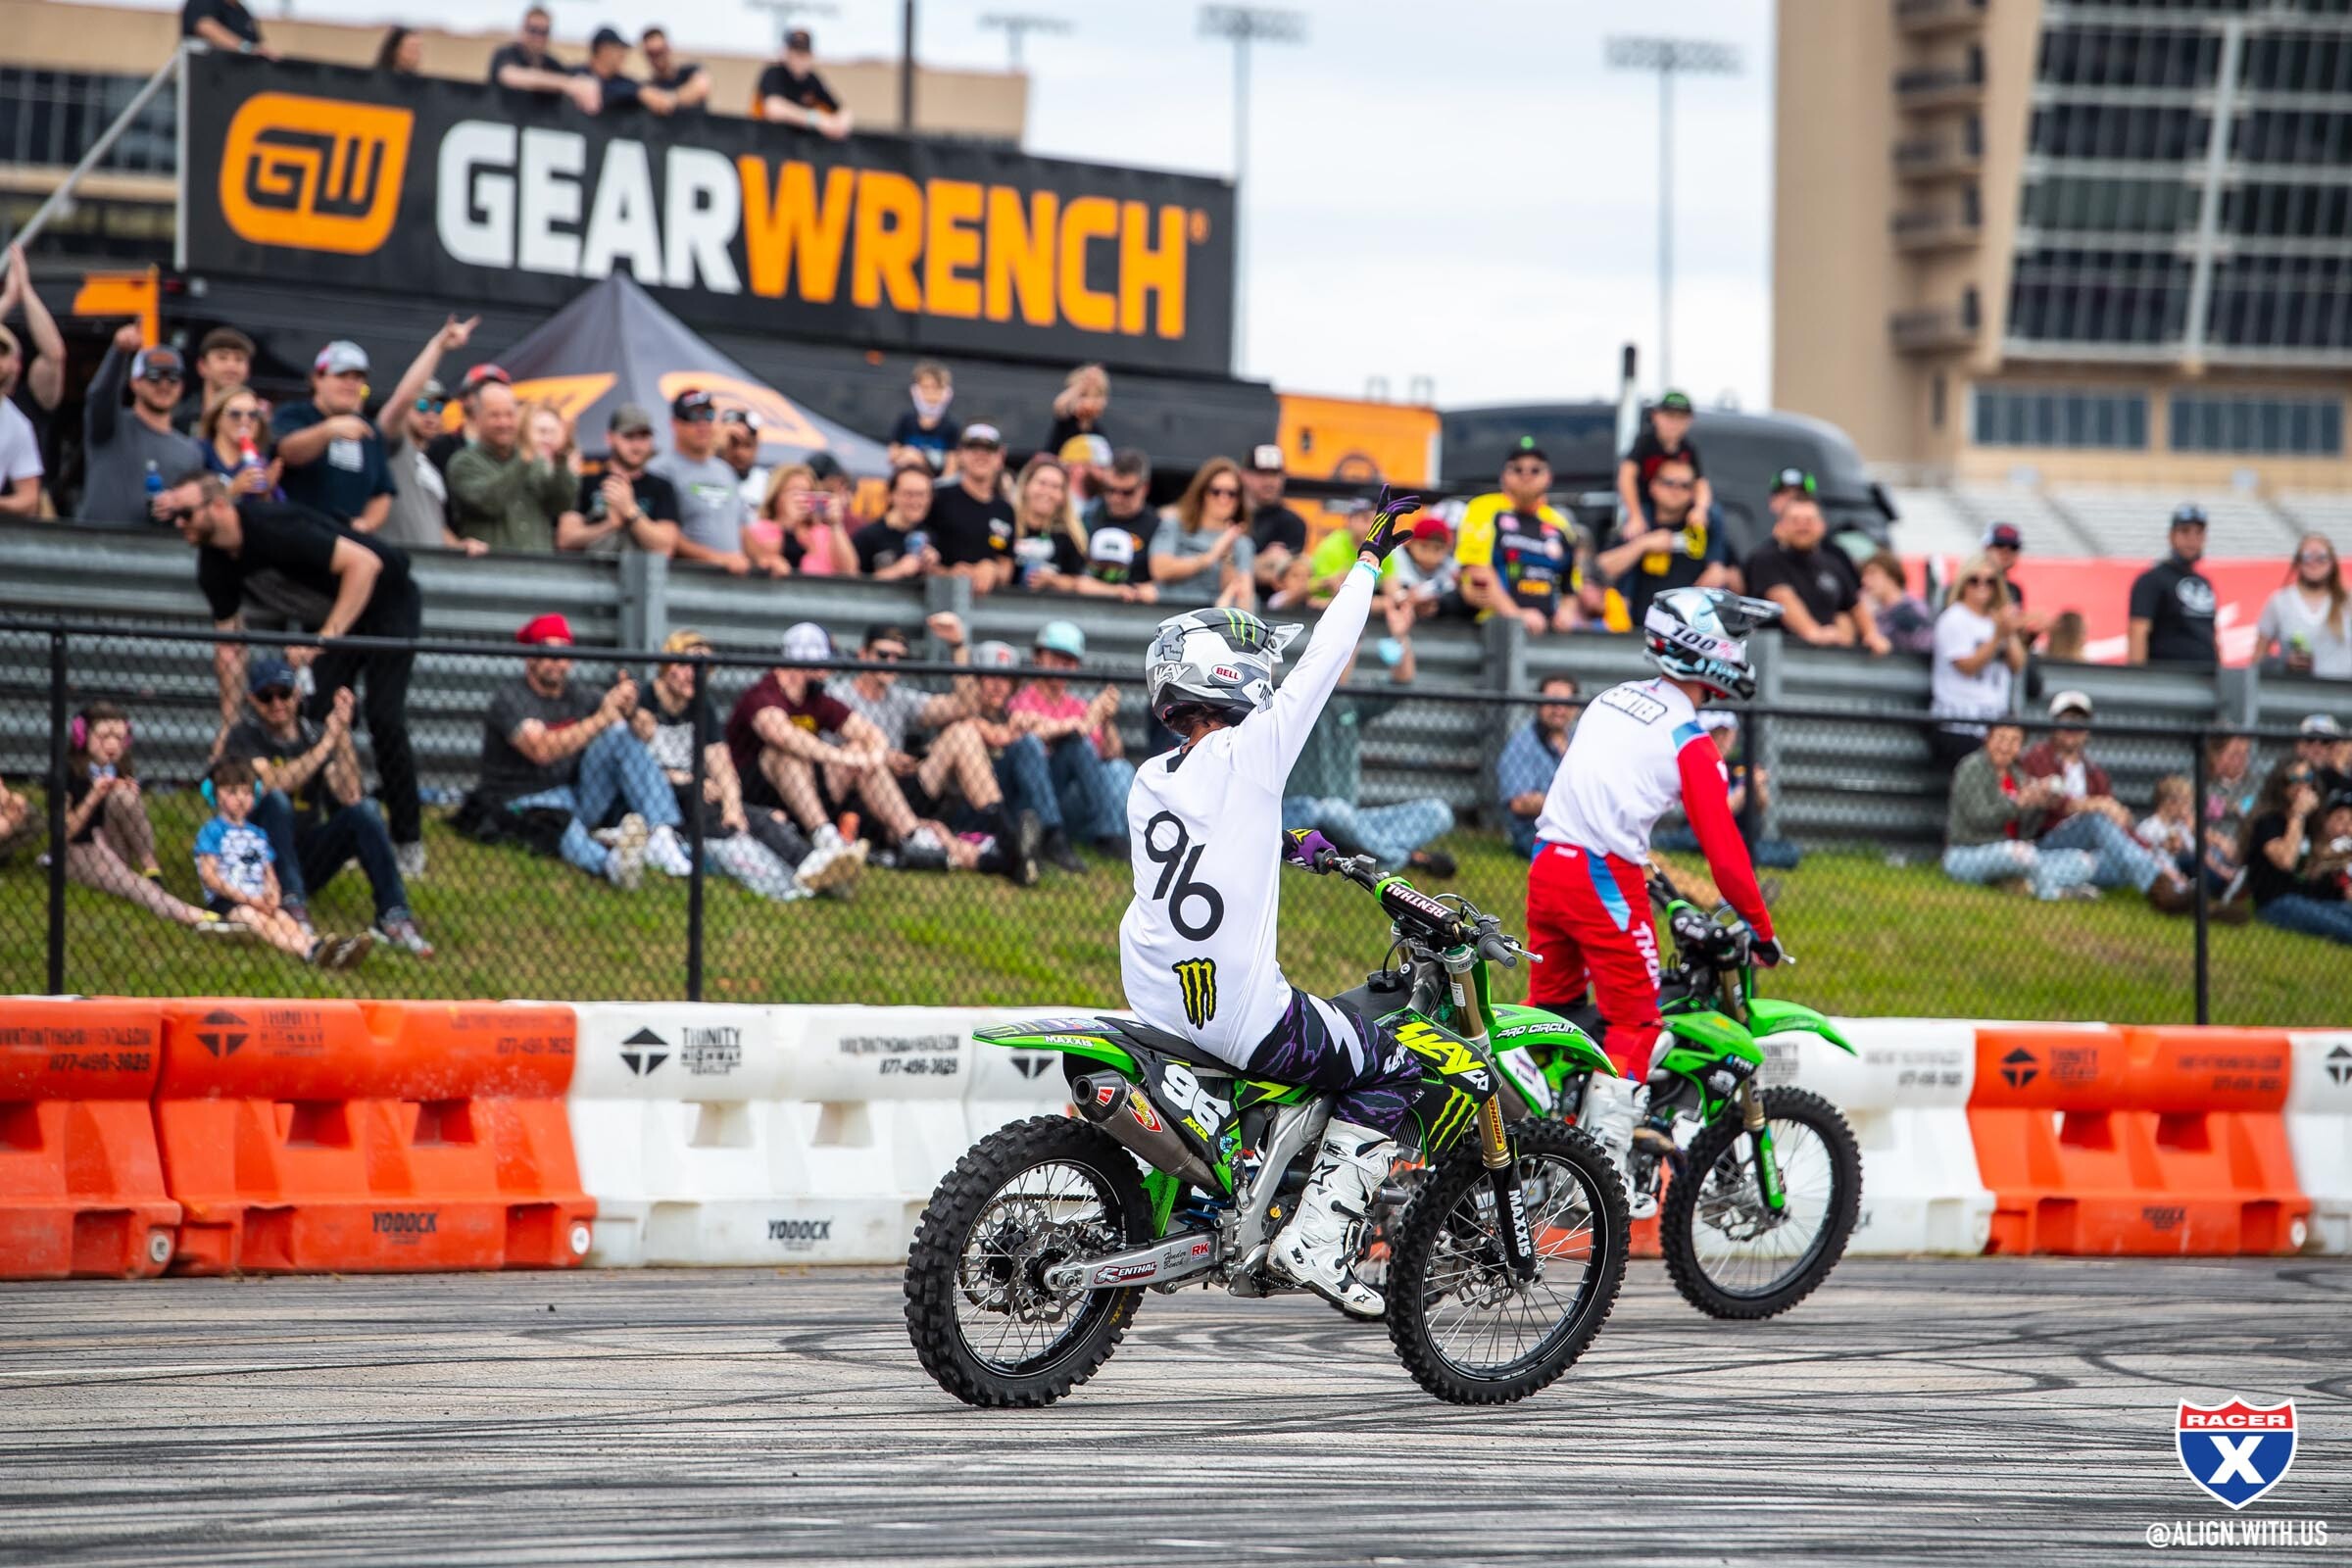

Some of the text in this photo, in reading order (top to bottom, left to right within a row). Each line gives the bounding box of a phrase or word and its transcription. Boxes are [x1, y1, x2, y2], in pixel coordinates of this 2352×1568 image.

[436, 120, 1187, 338] GEARWRENCH
[1672, 628, 1734, 659] 100%
[1215, 667, 1240, 681] BELL
[1144, 809, 1225, 942] 96
[1386, 884, 1448, 918] RENTHAL
[680, 1027, 742, 1047] TRINITY
[1494, 1022, 1577, 1039] PRO CIRCUIT
[1044, 1035, 1094, 1048] MAXXIS
[1160, 1064, 1232, 1137] 96
[372, 1211, 438, 1233] YODOCK
[768, 1221, 831, 1240] YODOCK
[1507, 1189, 1532, 1258] MAXXIS
[1192, 1242, 1210, 1256] RK
[1096, 1262, 1156, 1283] RENTHAL
